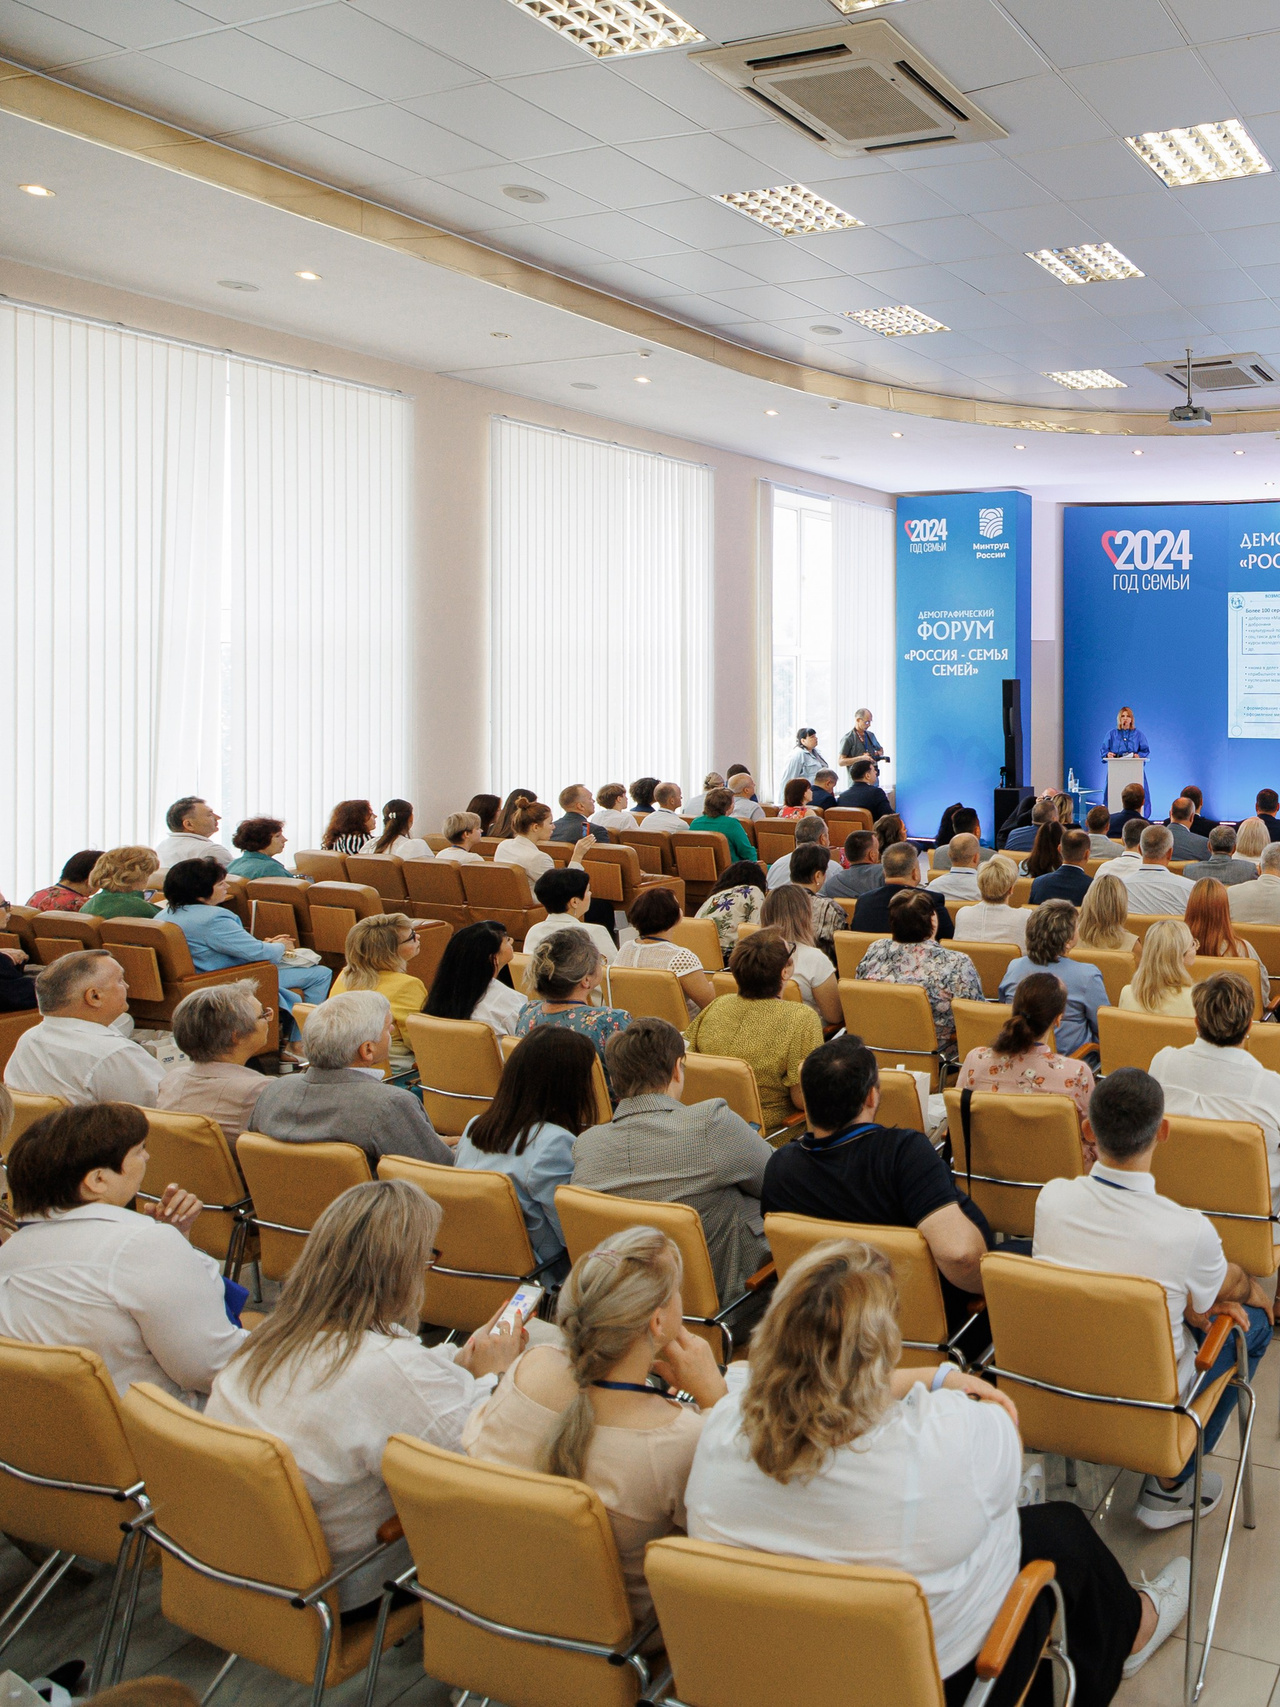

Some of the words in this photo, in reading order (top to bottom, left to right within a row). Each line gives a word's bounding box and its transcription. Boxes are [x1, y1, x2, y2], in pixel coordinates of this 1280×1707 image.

[910, 518, 948, 542] 2024
[972, 542, 1010, 551] Минтруд
[1114, 530, 1193, 570] 2024
[976, 552, 1006, 560] России
[918, 608, 994, 620] ДЕМОГРАФИЧЕСКИЙ
[917, 620, 994, 641] ФОРУМ
[904, 649, 957, 661] «РОССИЯ
[968, 649, 1009, 661] СЕМЬЯ
[932, 662, 979, 676] СЕМЕЙ»
